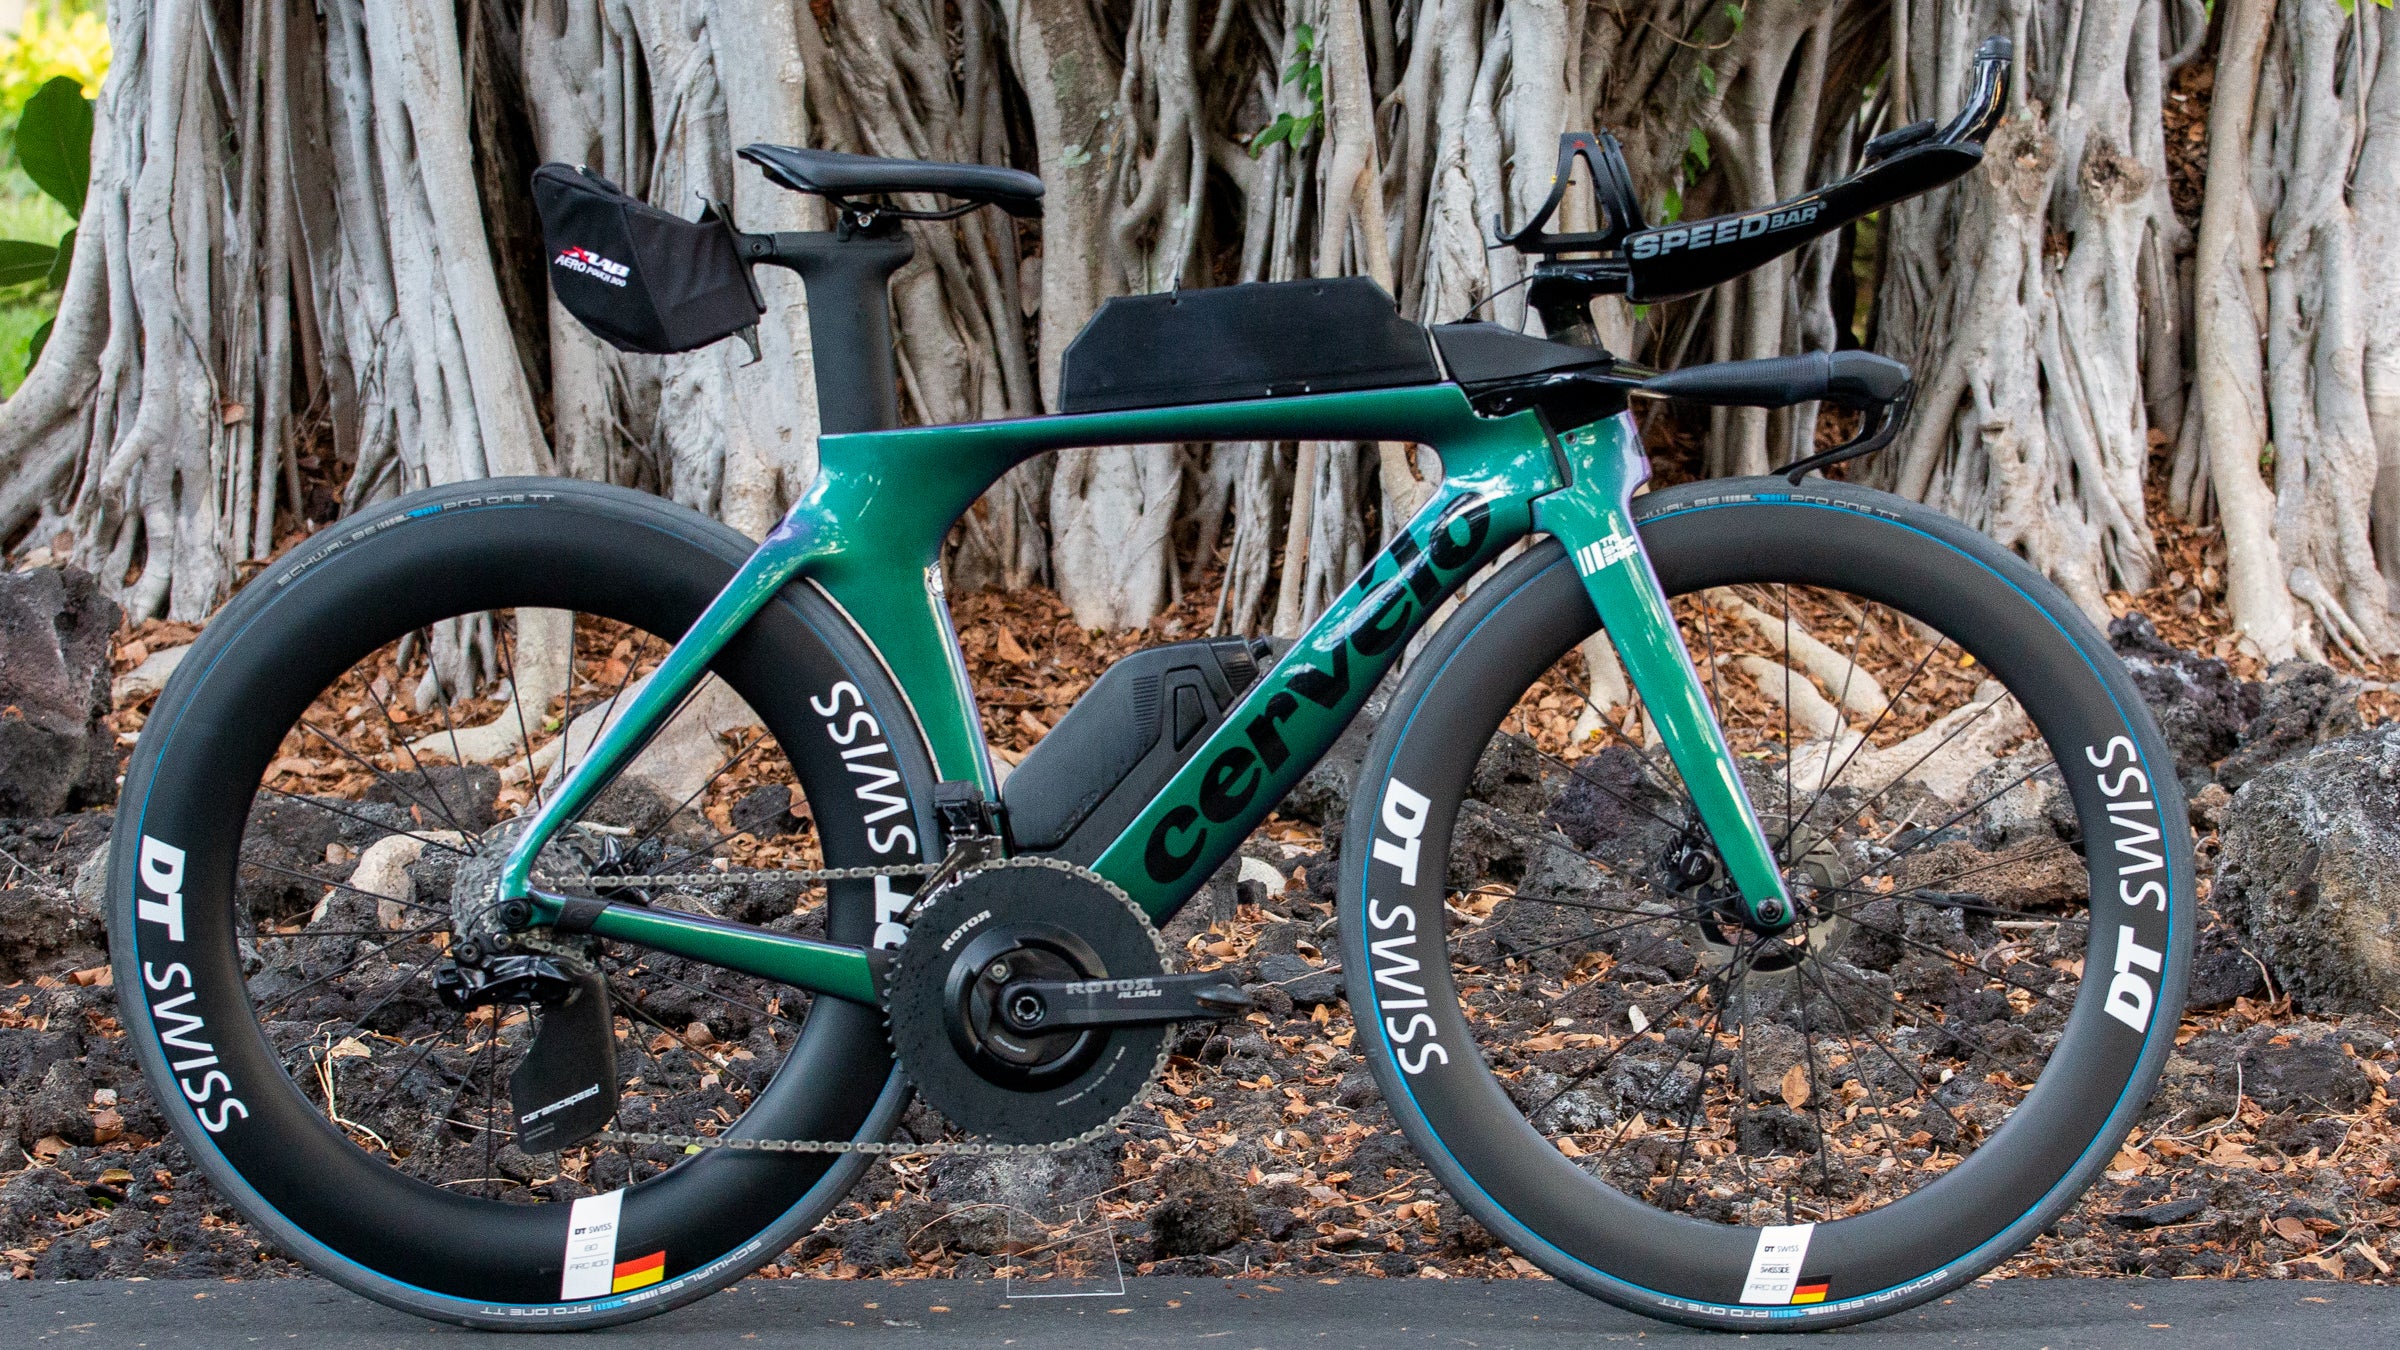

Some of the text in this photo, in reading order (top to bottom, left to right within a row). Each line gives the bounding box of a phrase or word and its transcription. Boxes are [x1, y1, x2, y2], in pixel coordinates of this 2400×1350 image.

[554, 254, 587, 273] AERO
[1634, 496, 1720, 522] HWALBE
[1876, 508, 1901, 520] TT
[277, 525, 377, 587] SCHWALBE
[528, 494, 555, 502] TT
[1143, 491, 1493, 885] cervélo
[810, 680, 917, 855] SWISS
[2085, 735, 2167, 1034] DT SWISS
[941, 909, 992, 951] ROTOR
[1368, 777, 1449, 1075] DT SWISS
[138, 834, 249, 1133] DT SWISS
[1065, 977, 1154, 995] ROTOR
[574, 1222, 613, 1236] DT SWISS
[1763, 1244, 1800, 1253] DT SWISS
[659, 1239, 762, 1295] SCHWALBE
[1657, 1298, 1683, 1309] TT
[1838, 1268, 1949, 1311] SCHWALBE
[480, 1306, 506, 1316] TT
